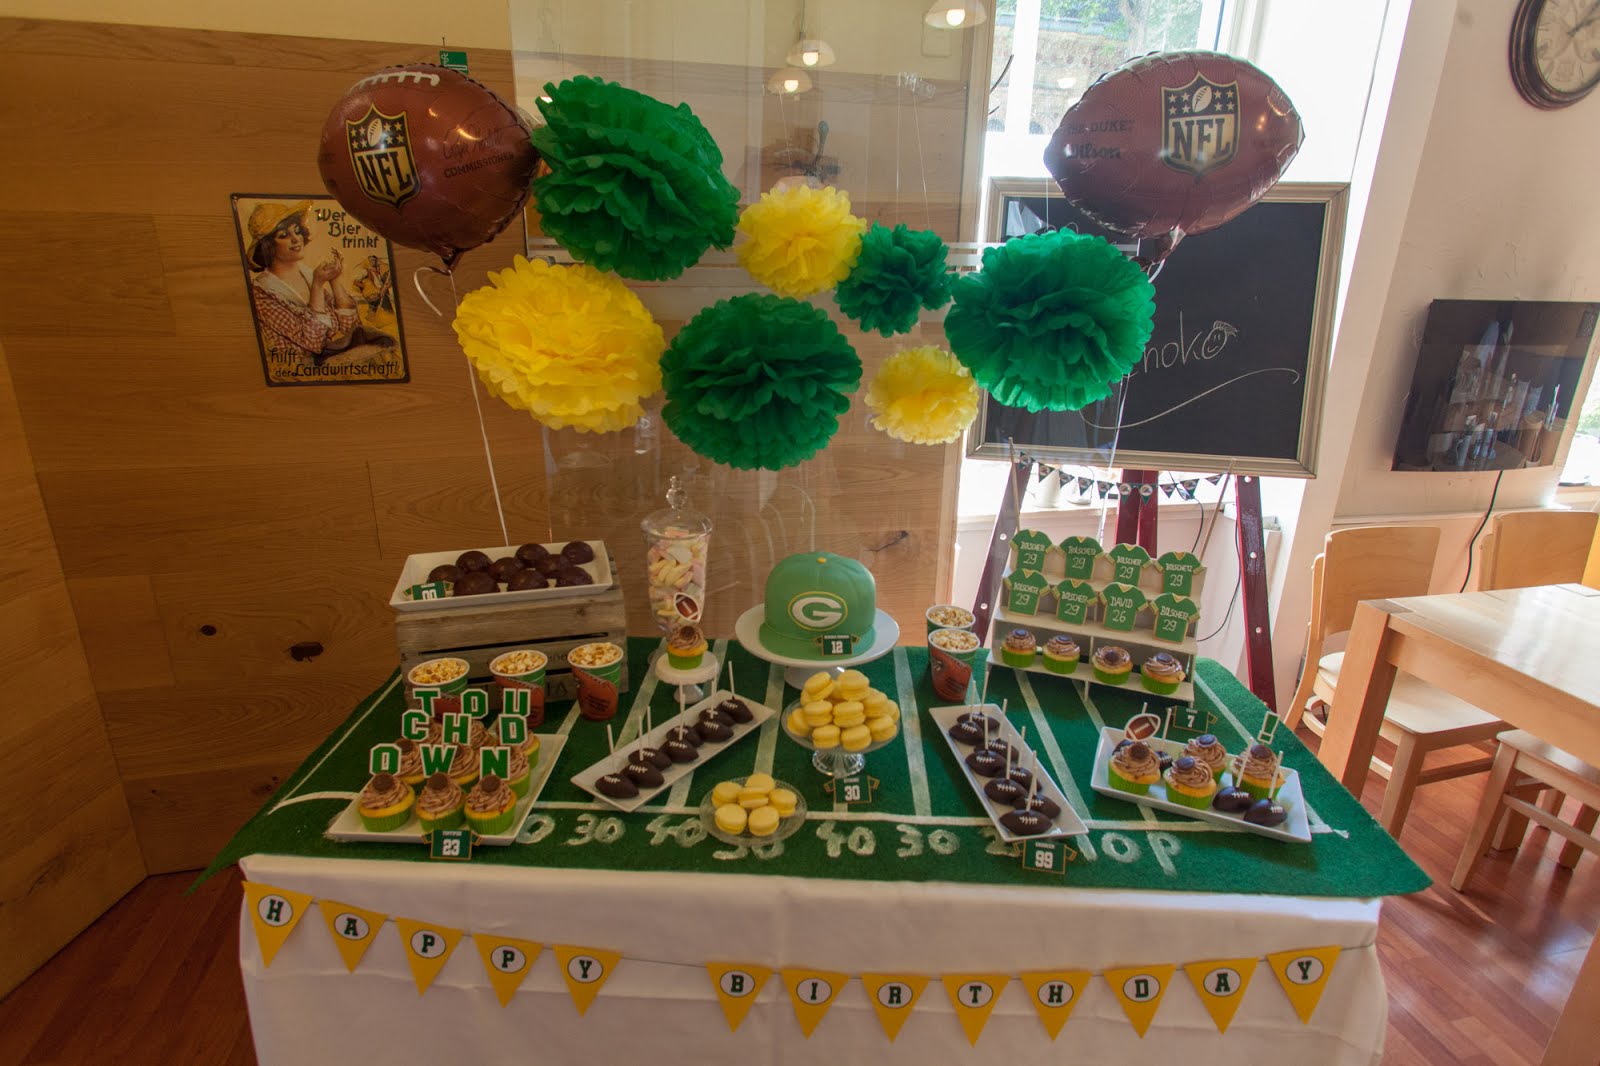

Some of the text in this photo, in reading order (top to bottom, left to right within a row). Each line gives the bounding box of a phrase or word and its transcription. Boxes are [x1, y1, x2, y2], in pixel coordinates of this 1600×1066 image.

[1171, 118, 1231, 161] NFL
[443, 152, 514, 178] COMMISSIONER
[357, 151, 411, 197] NFL
[314, 208, 346, 221] Wer
[328, 222, 361, 237] Bier
[342, 236, 379, 248] trinkt
[268, 347, 297, 366] hilft
[276, 361, 398, 377] der Landwirtschaft!
[1023, 553, 1038, 565] 29
[1071, 557, 1086, 569] 29
[1119, 566, 1134, 579] 29
[1169, 574, 1184, 587] 29
[1015, 593, 1030, 606] 29
[1110, 595, 1133, 608] DAVID
[791, 596, 842, 628] G
[1064, 603, 1080, 616] 29
[1112, 609, 1127, 623] 26
[1162, 619, 1177, 632] 29
[831, 641, 843, 654] 12
[1187, 715, 1195, 728] 7
[844, 785, 860, 801] 30
[563, 812, 626, 846] 30
[646, 814, 709, 848] 40
[815, 820, 876, 858] 40
[896, 823, 960, 858] 30
[442, 839, 460, 856] 23
[1035, 850, 1053, 869] 99
